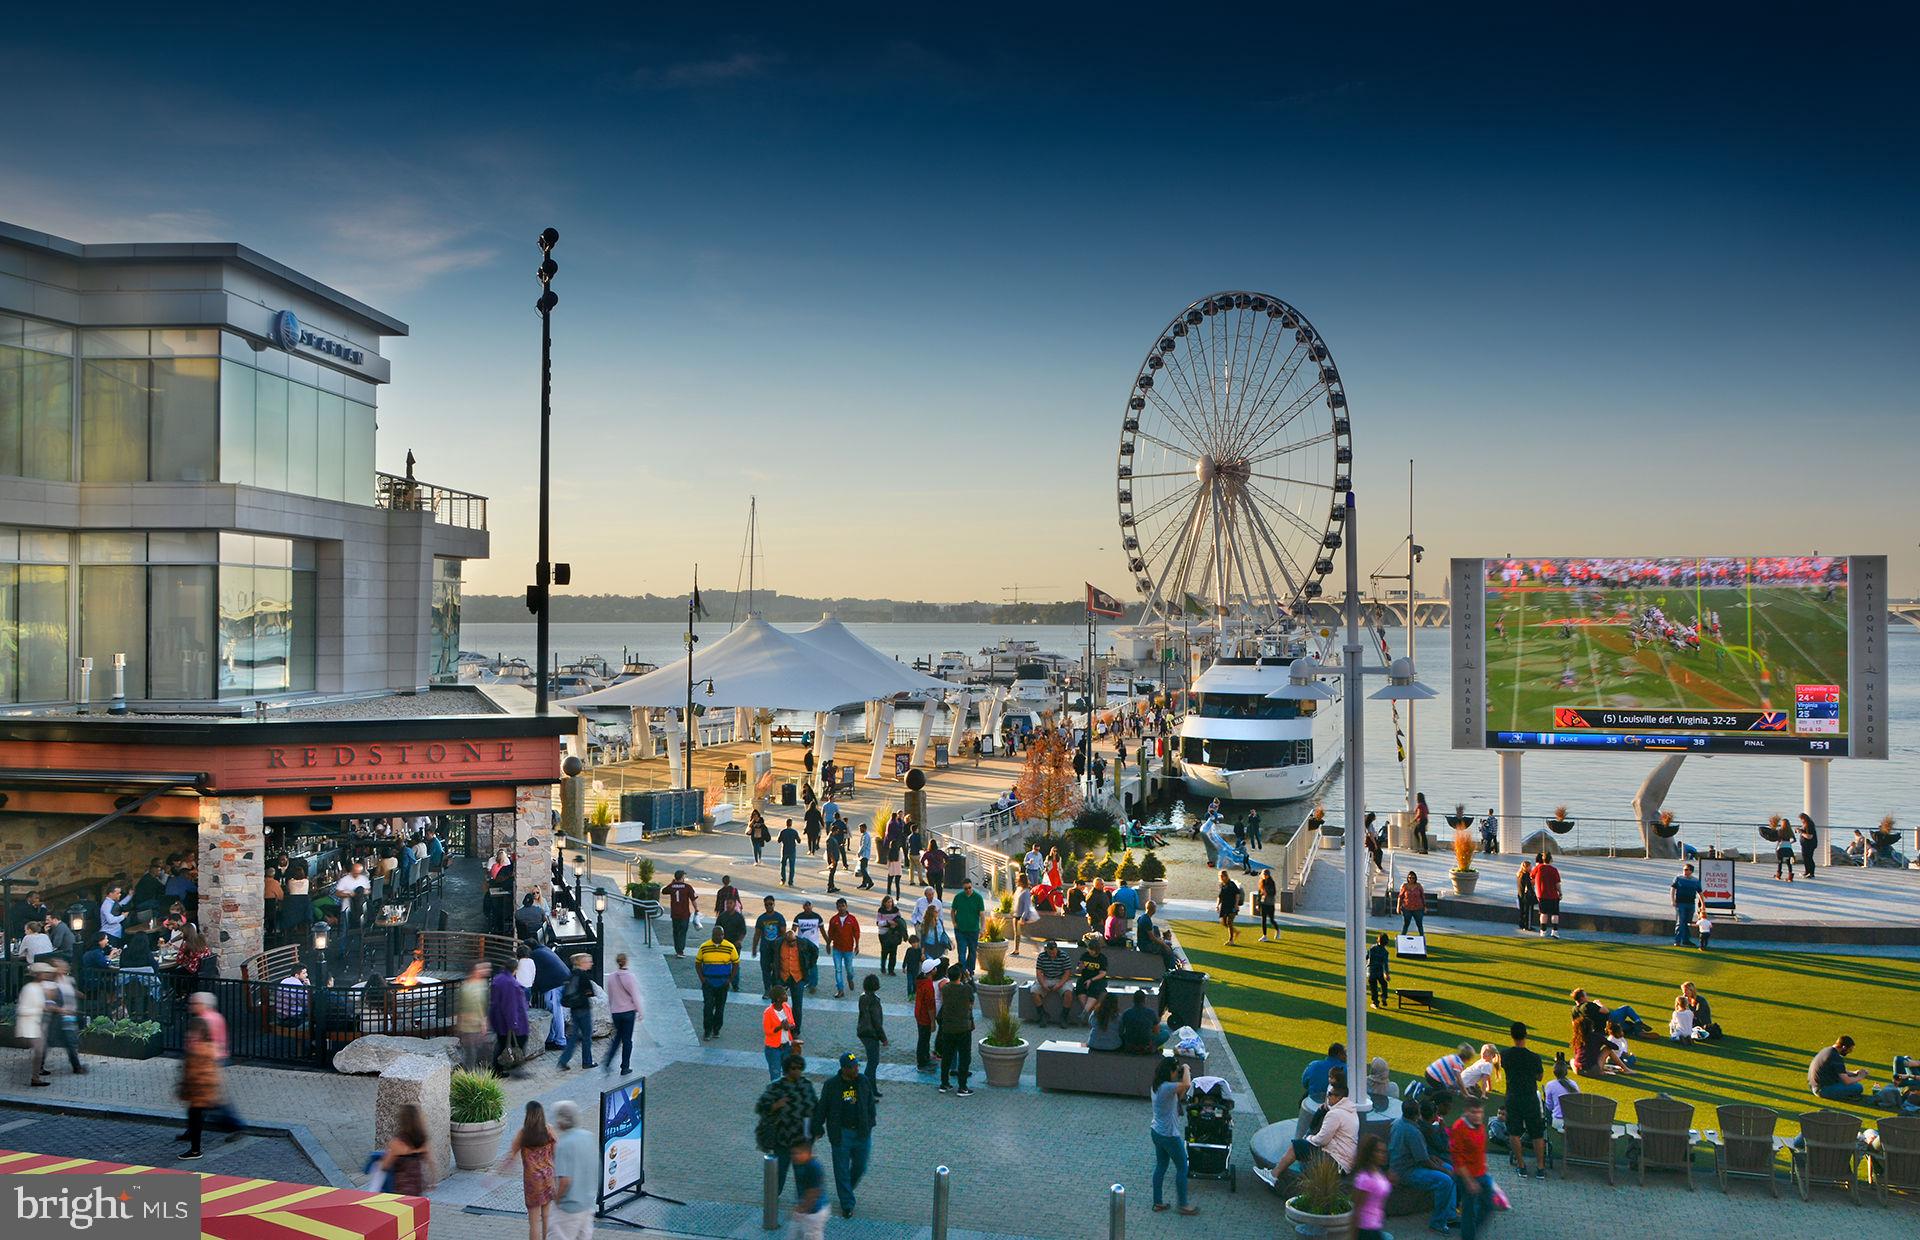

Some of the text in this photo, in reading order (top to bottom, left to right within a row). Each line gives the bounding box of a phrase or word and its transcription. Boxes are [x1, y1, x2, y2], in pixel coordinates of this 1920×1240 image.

[1464, 678, 1472, 734] HARBOR
[1866, 683, 1874, 744] HARBOR
[1603, 714, 1737, 725] (5) Louisville def. Virginia, 32-25
[1606, 736, 1617, 744] 35
[1693, 738, 1705, 746] 38
[1810, 741, 1830, 750] FS1
[268, 742, 514, 769] REDSTONE
[342, 773, 403, 781] AMERICAN
